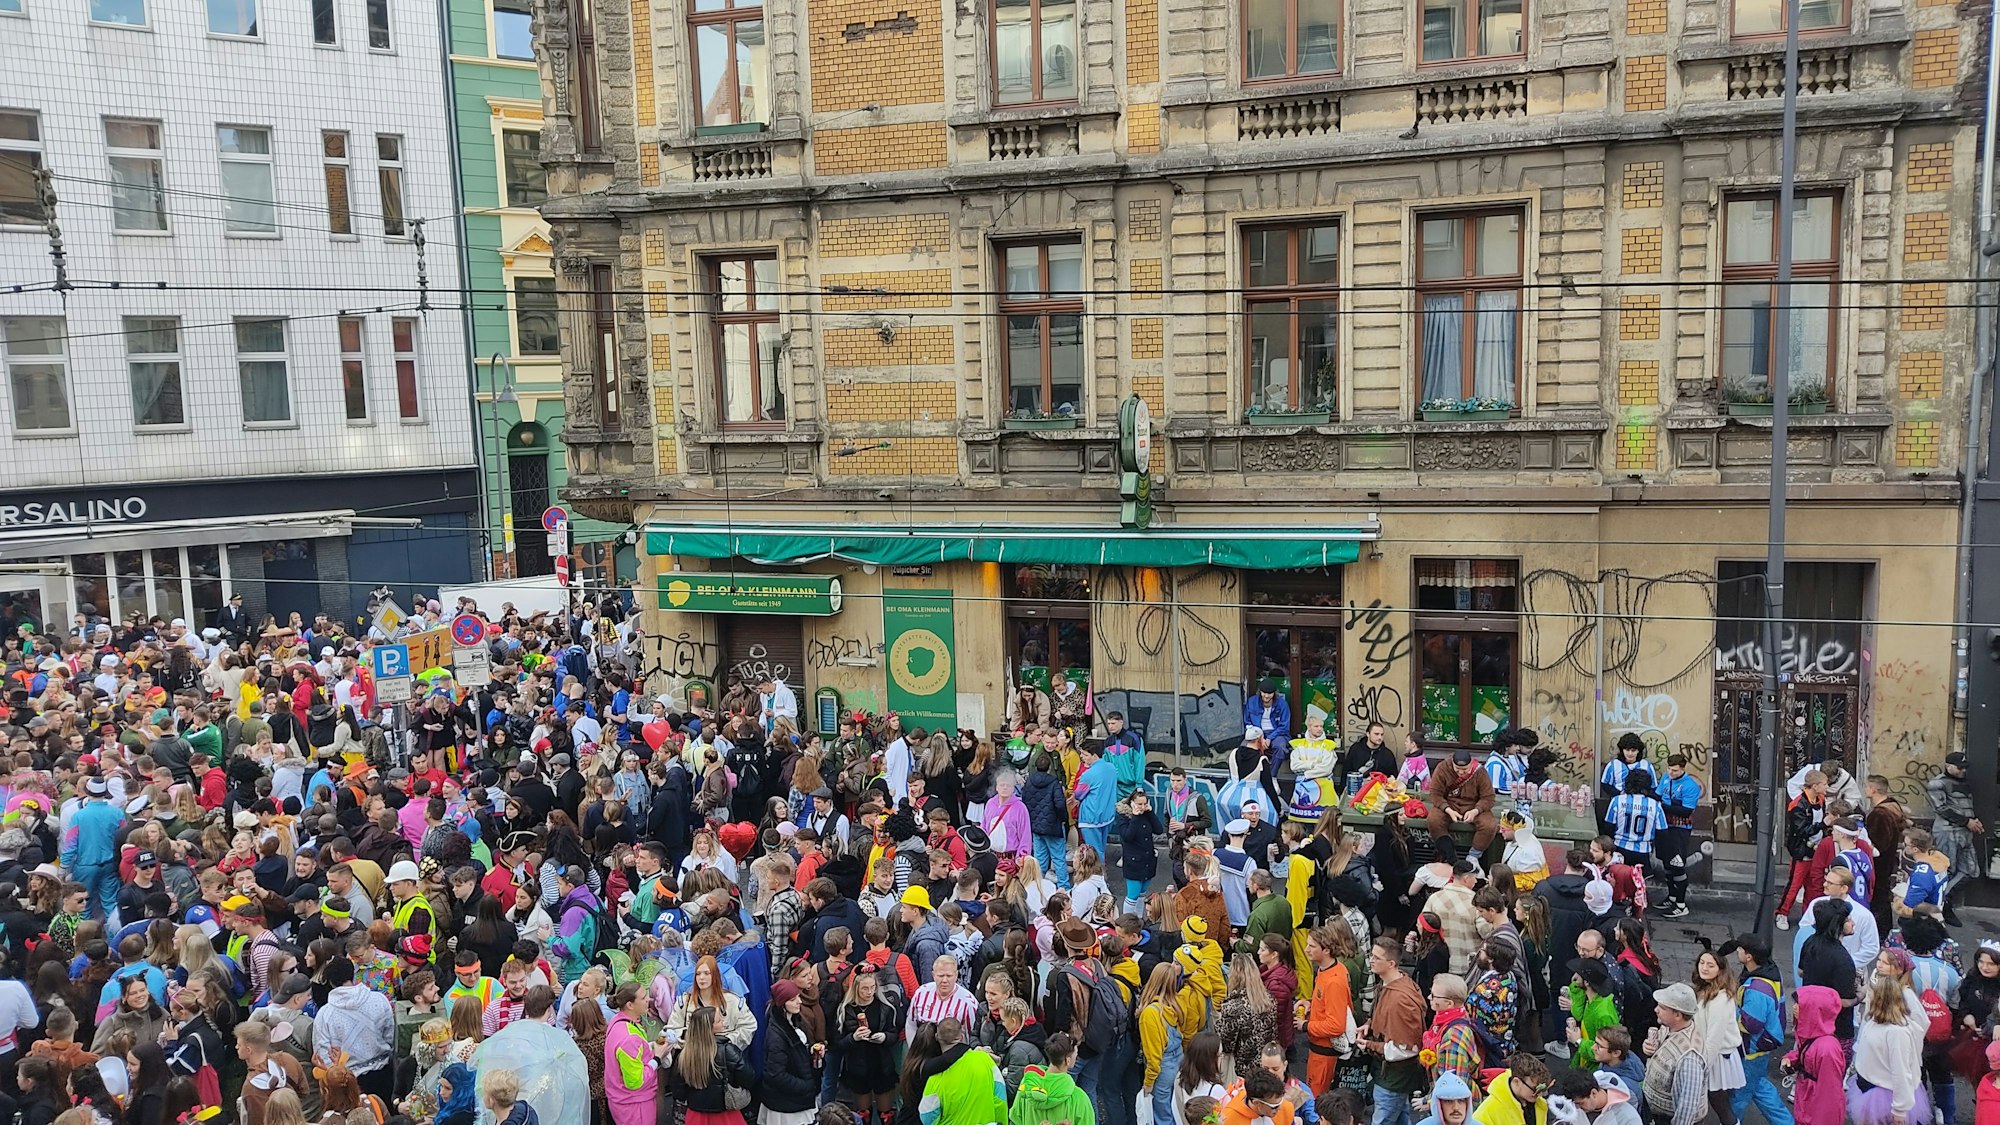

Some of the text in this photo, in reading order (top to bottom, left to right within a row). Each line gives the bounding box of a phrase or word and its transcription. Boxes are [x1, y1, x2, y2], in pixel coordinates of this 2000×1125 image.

[697, 585, 817, 599] BEI OMA KLEINMANN
[769, 600, 782, 608] 1949
[913, 606, 950, 614] KLEINMANN
[381, 649, 401, 675] P
[916, 710, 955, 719] Willkommen
[736, 753, 757, 761] FBI
[1625, 812, 1648, 835] 10
[140, 852, 153, 862] FBI
[1854, 875, 1865, 899] 6
